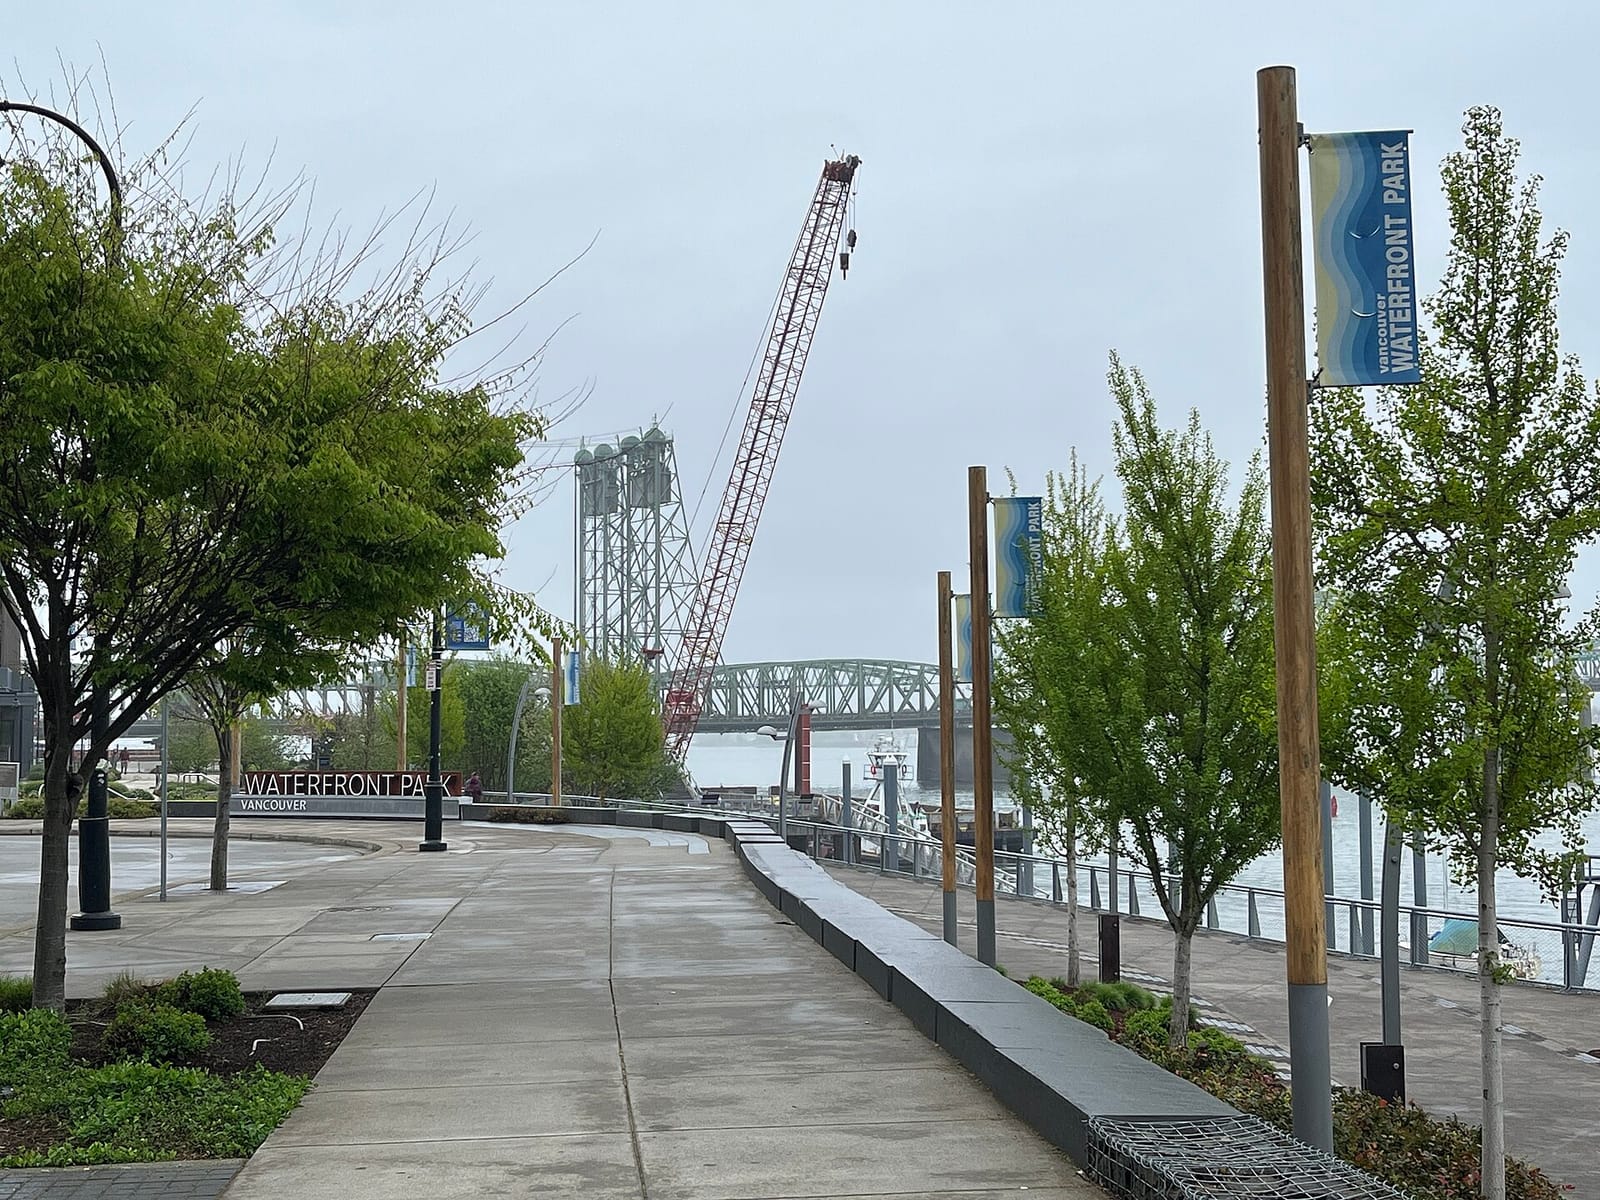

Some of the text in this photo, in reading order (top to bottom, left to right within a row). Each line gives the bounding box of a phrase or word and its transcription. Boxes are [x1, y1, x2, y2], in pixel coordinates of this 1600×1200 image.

[1381, 142, 1415, 374] WATERFRONT PARK
[1377, 294, 1388, 374] vancouver
[1028, 502, 1040, 532] PARK
[246, 774, 394, 796] WATERFRONT
[241, 800, 307, 811] VANCOUVER
